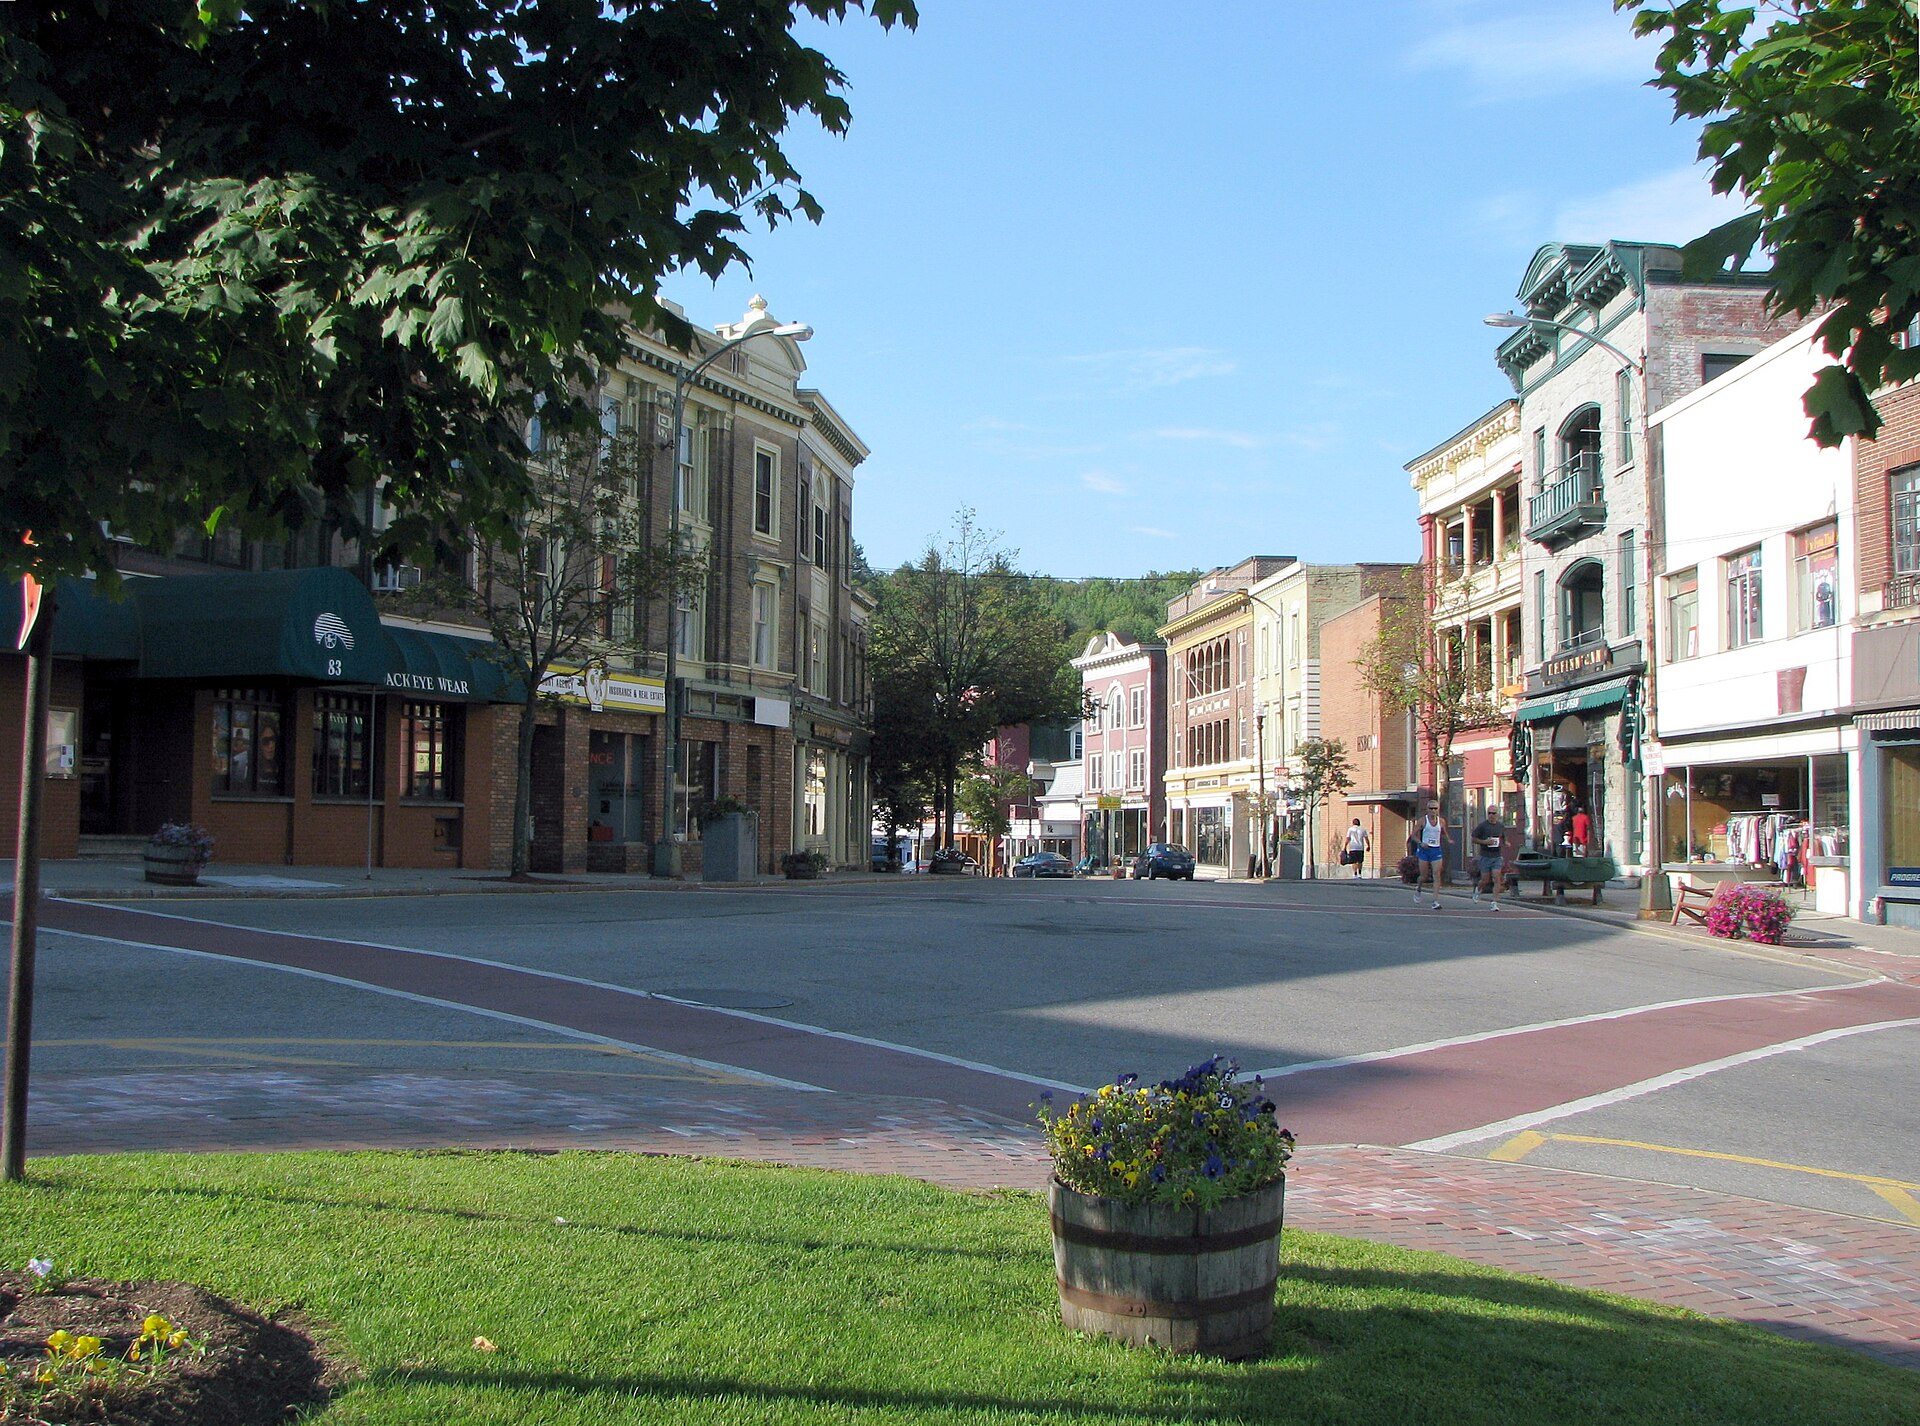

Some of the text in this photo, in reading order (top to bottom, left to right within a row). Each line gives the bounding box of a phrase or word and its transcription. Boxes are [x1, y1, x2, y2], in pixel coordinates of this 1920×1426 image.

[328, 659, 342, 676] 83
[386, 672, 469, 694] ACK EYE WEAR
[609, 686, 632, 697] INSURANCE
[638, 690, 648, 700] REAL
[650, 691, 664, 701] ESTATE
[1275, 768, 1289, 776] STOP
[1890, 873, 1920, 881] PROGRE
